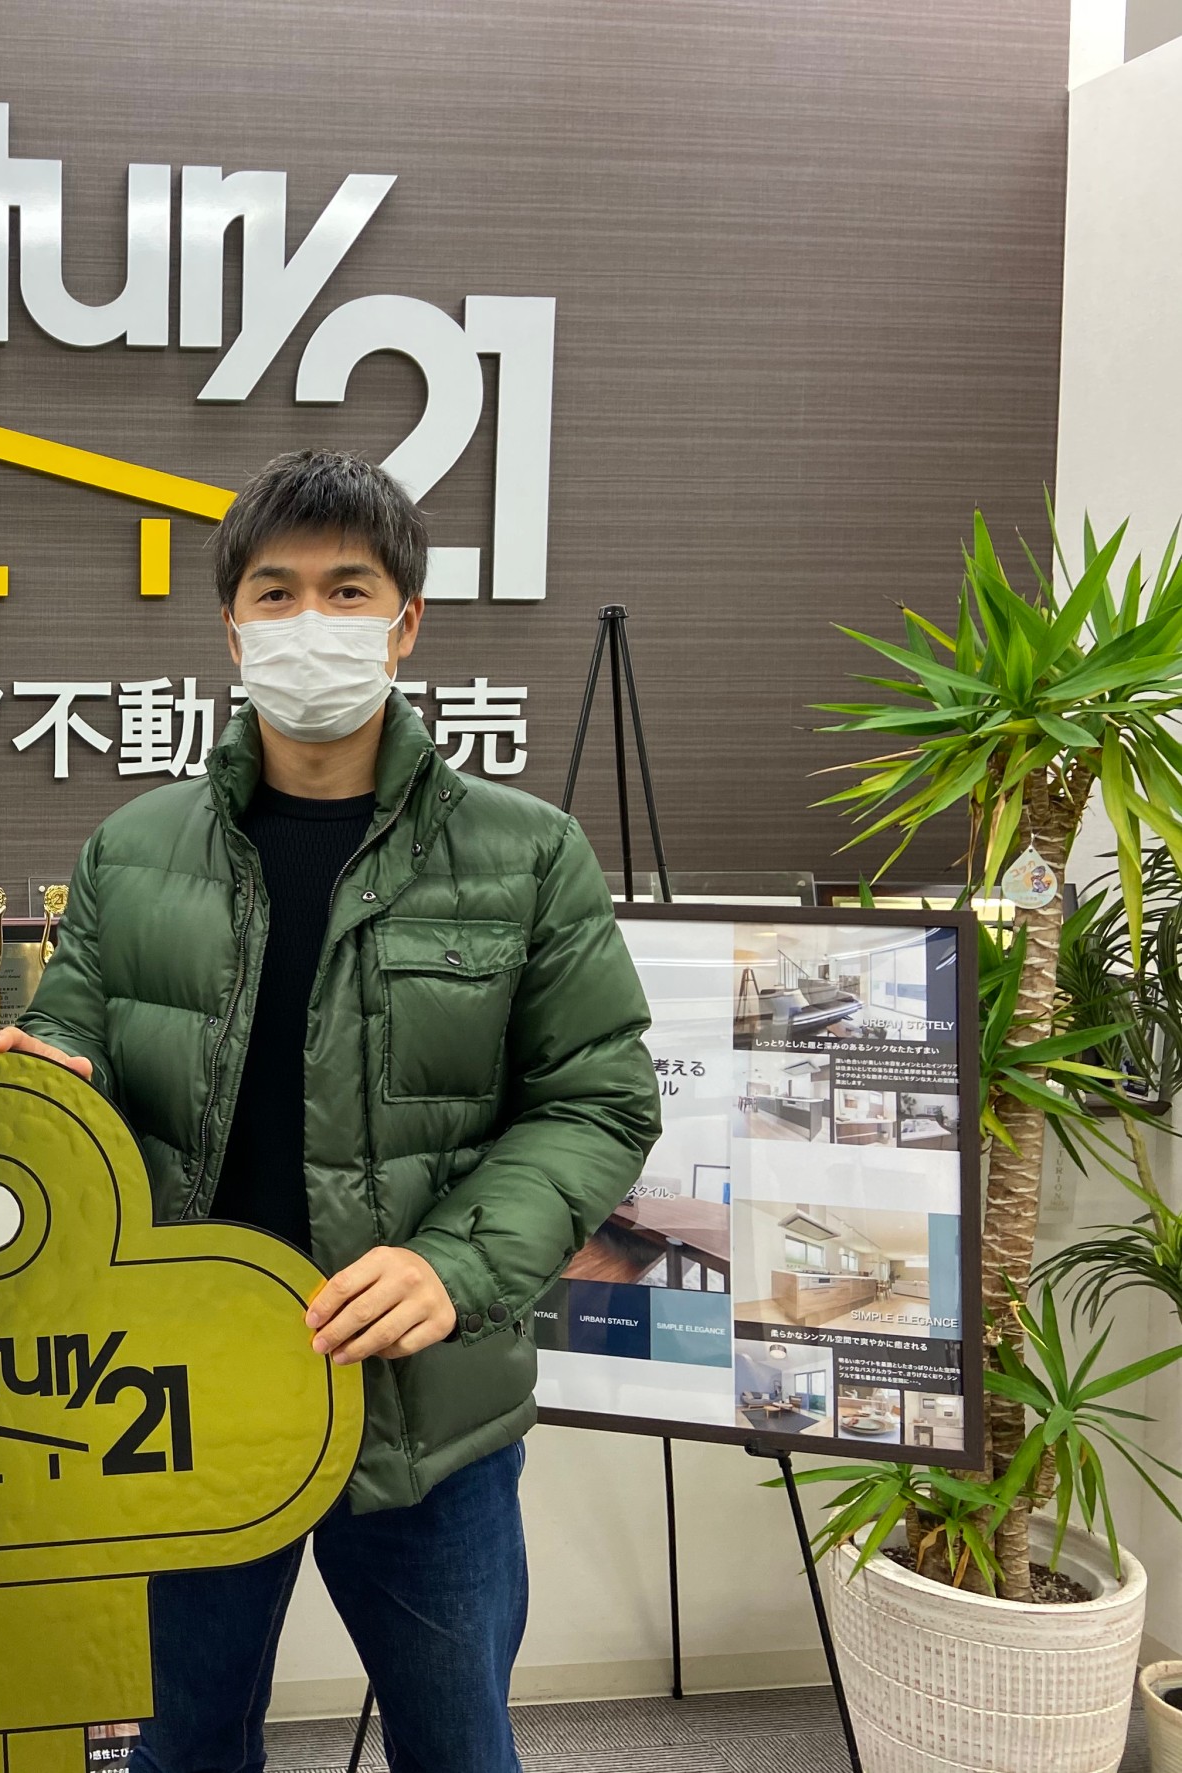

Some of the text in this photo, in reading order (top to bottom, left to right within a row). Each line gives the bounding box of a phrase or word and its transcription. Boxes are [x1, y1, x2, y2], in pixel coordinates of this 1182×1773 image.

[295, 293, 557, 602] 21
[53, 893, 65, 906] 21
[862, 1018, 955, 1031] URBAN STATELY
[579, 1314, 640, 1328] URBAN STATELY
[850, 1309, 960, 1329] SIMPLE ELEGANCE
[656, 1321, 726, 1336] SIMPLE ELEGANCE
[770, 1328, 929, 1353] 柔らかなシンプル空間で爽やかに癒される
[94, 1364, 194, 1477] 21
